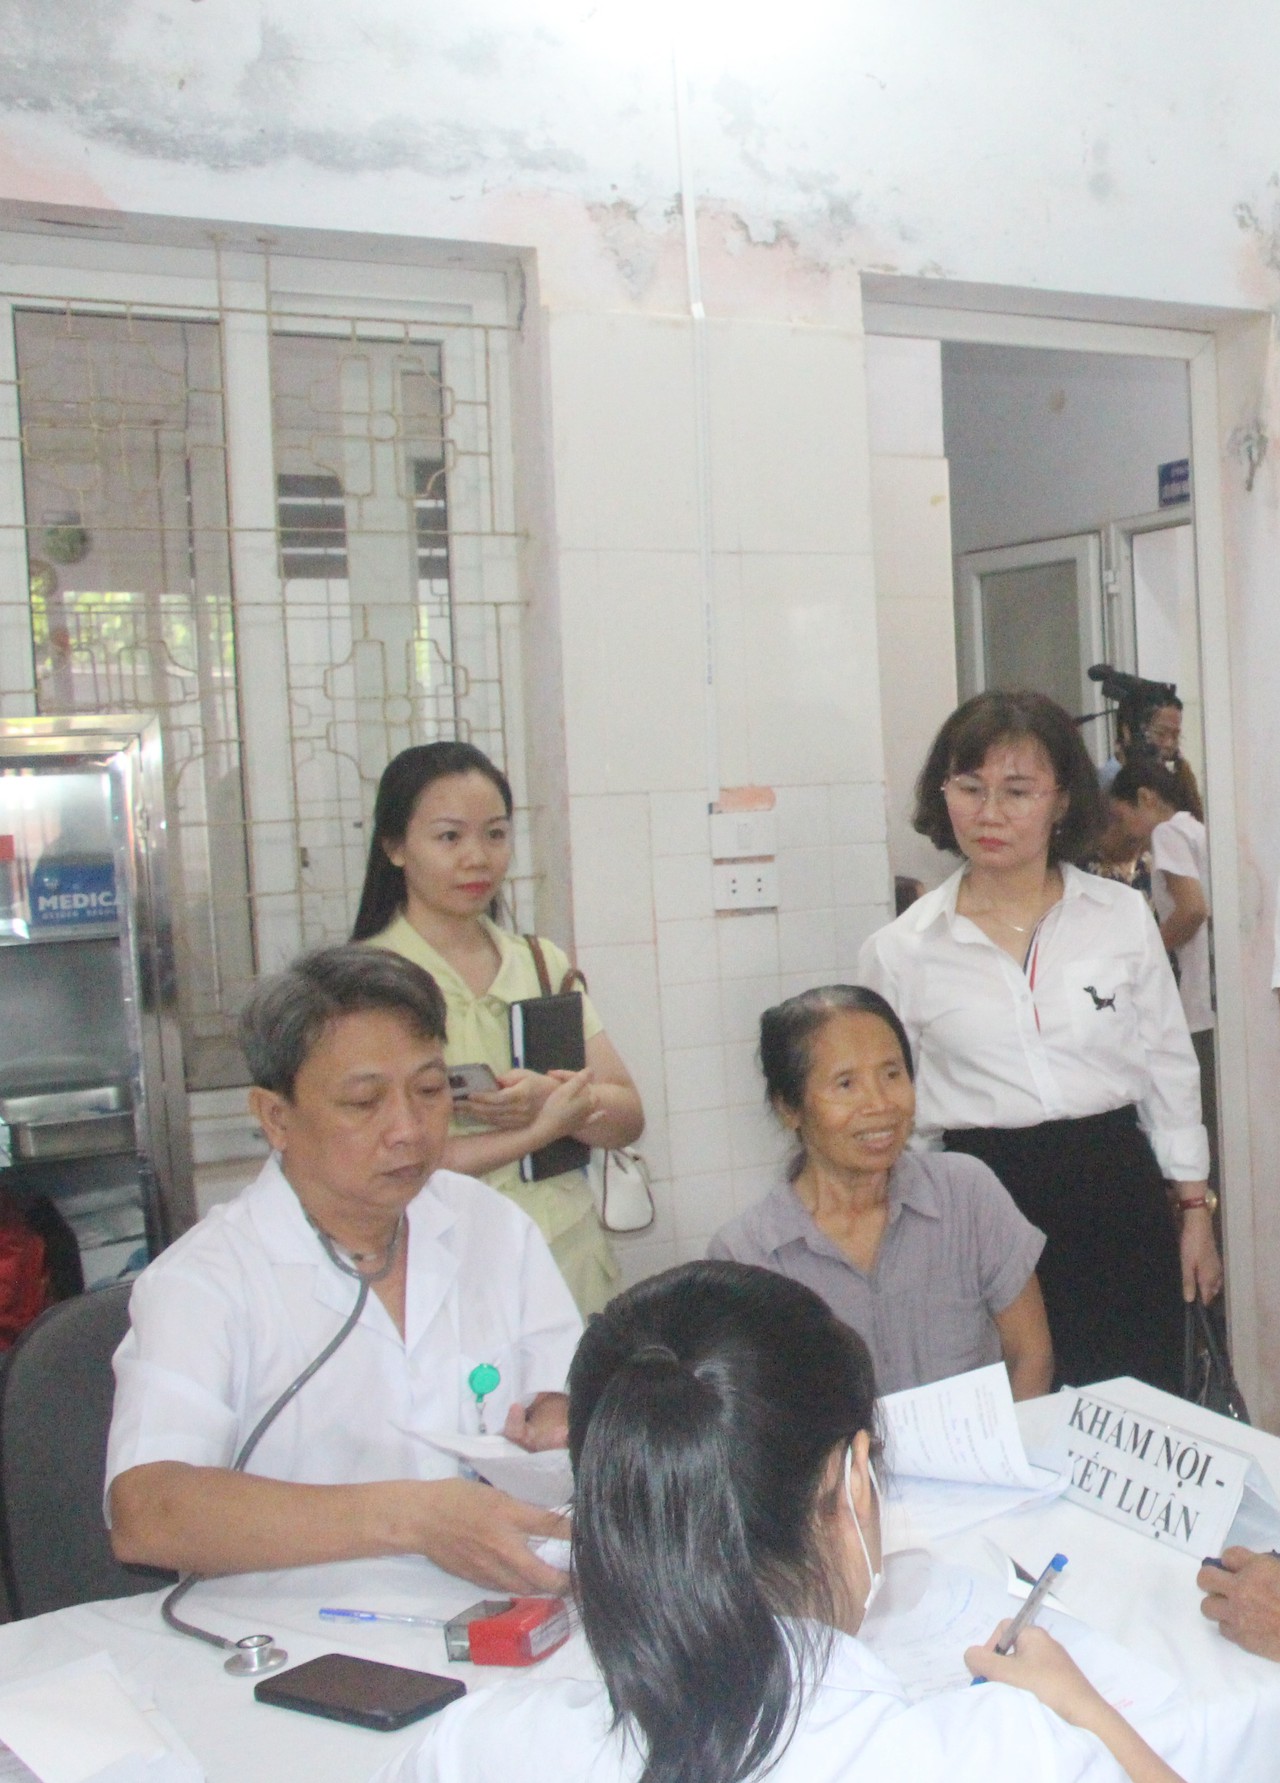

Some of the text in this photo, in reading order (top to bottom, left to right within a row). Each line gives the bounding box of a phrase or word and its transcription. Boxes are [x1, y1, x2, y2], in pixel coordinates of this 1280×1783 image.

[38, 890, 119, 911] MEDIC
[1067, 1397, 1154, 1460] KHÁM
[1154, 1435, 1211, 1488] NỘI
[1117, 1478, 1201, 1544] LUẬN
